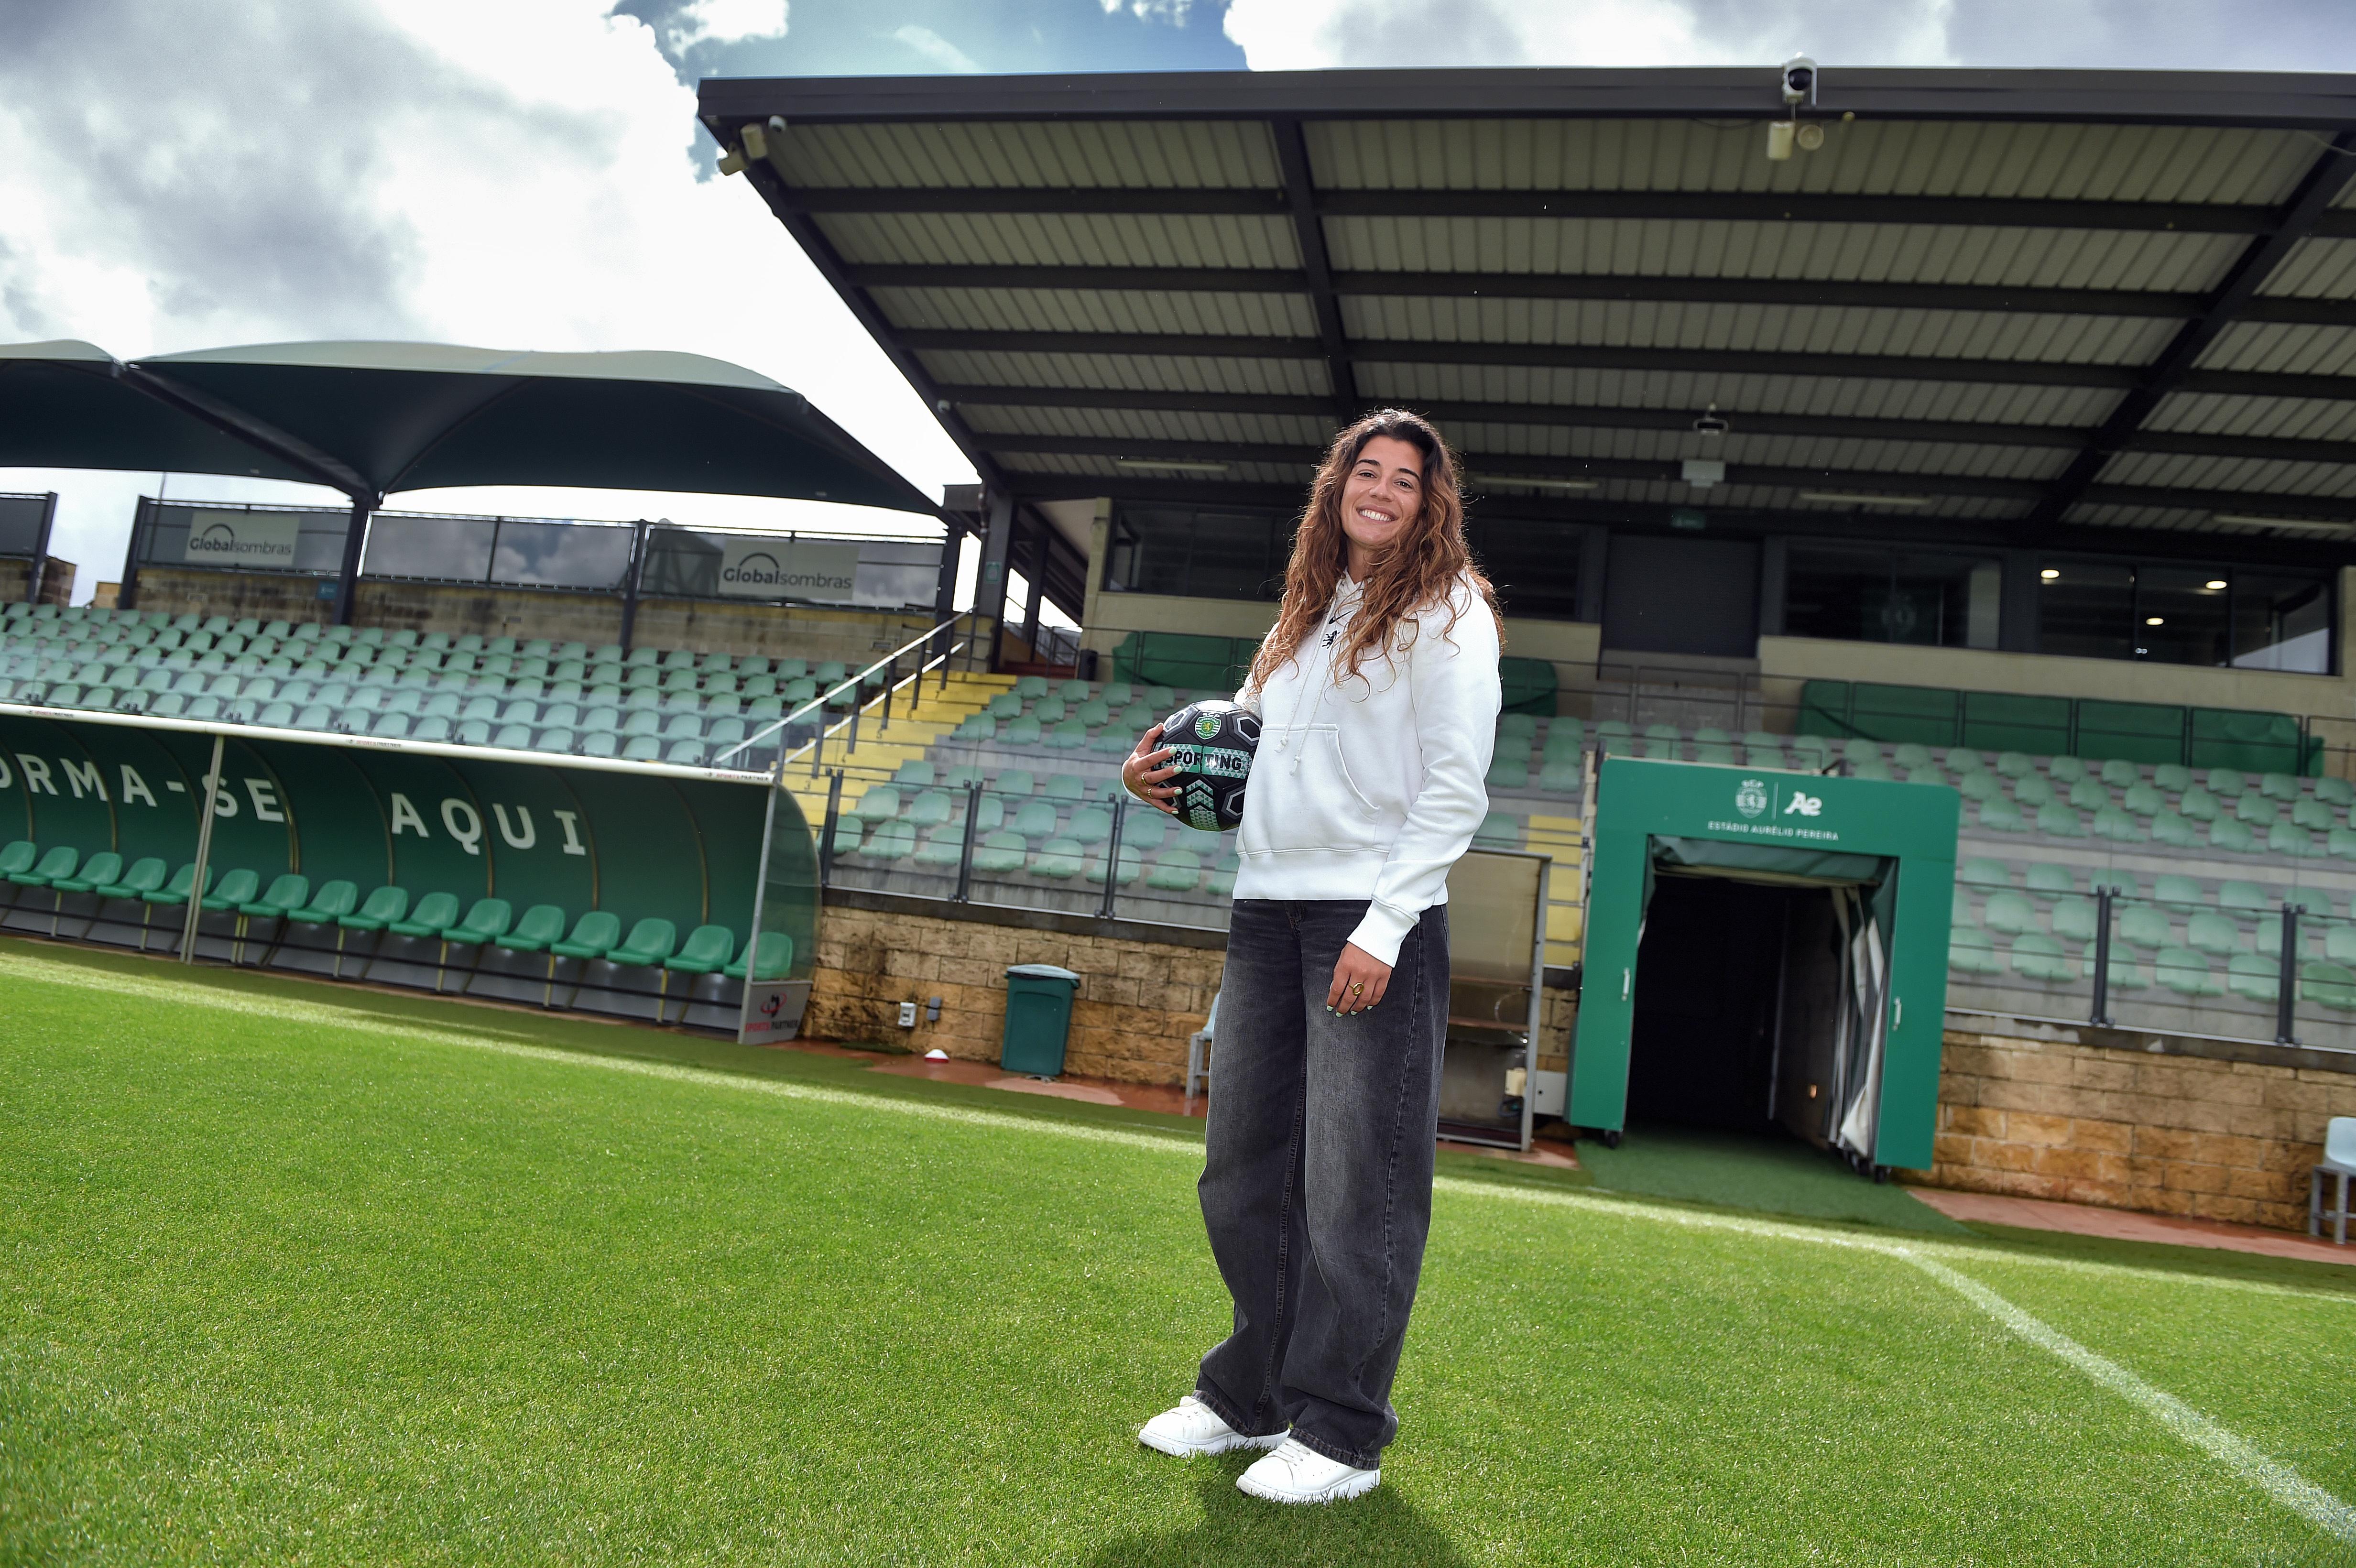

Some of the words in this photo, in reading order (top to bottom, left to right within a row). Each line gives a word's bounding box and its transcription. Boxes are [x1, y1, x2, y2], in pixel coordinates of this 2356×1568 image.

[190, 537, 292, 555] Globalsombras
[723, 568, 852, 589] Globalsombras
[391, 792, 587, 856] AQUI
[1707, 820, 1749, 833] ESTÁDIO
[1750, 825, 1794, 837] AURÉLIO
[1795, 828, 1839, 841] PEREIRA
